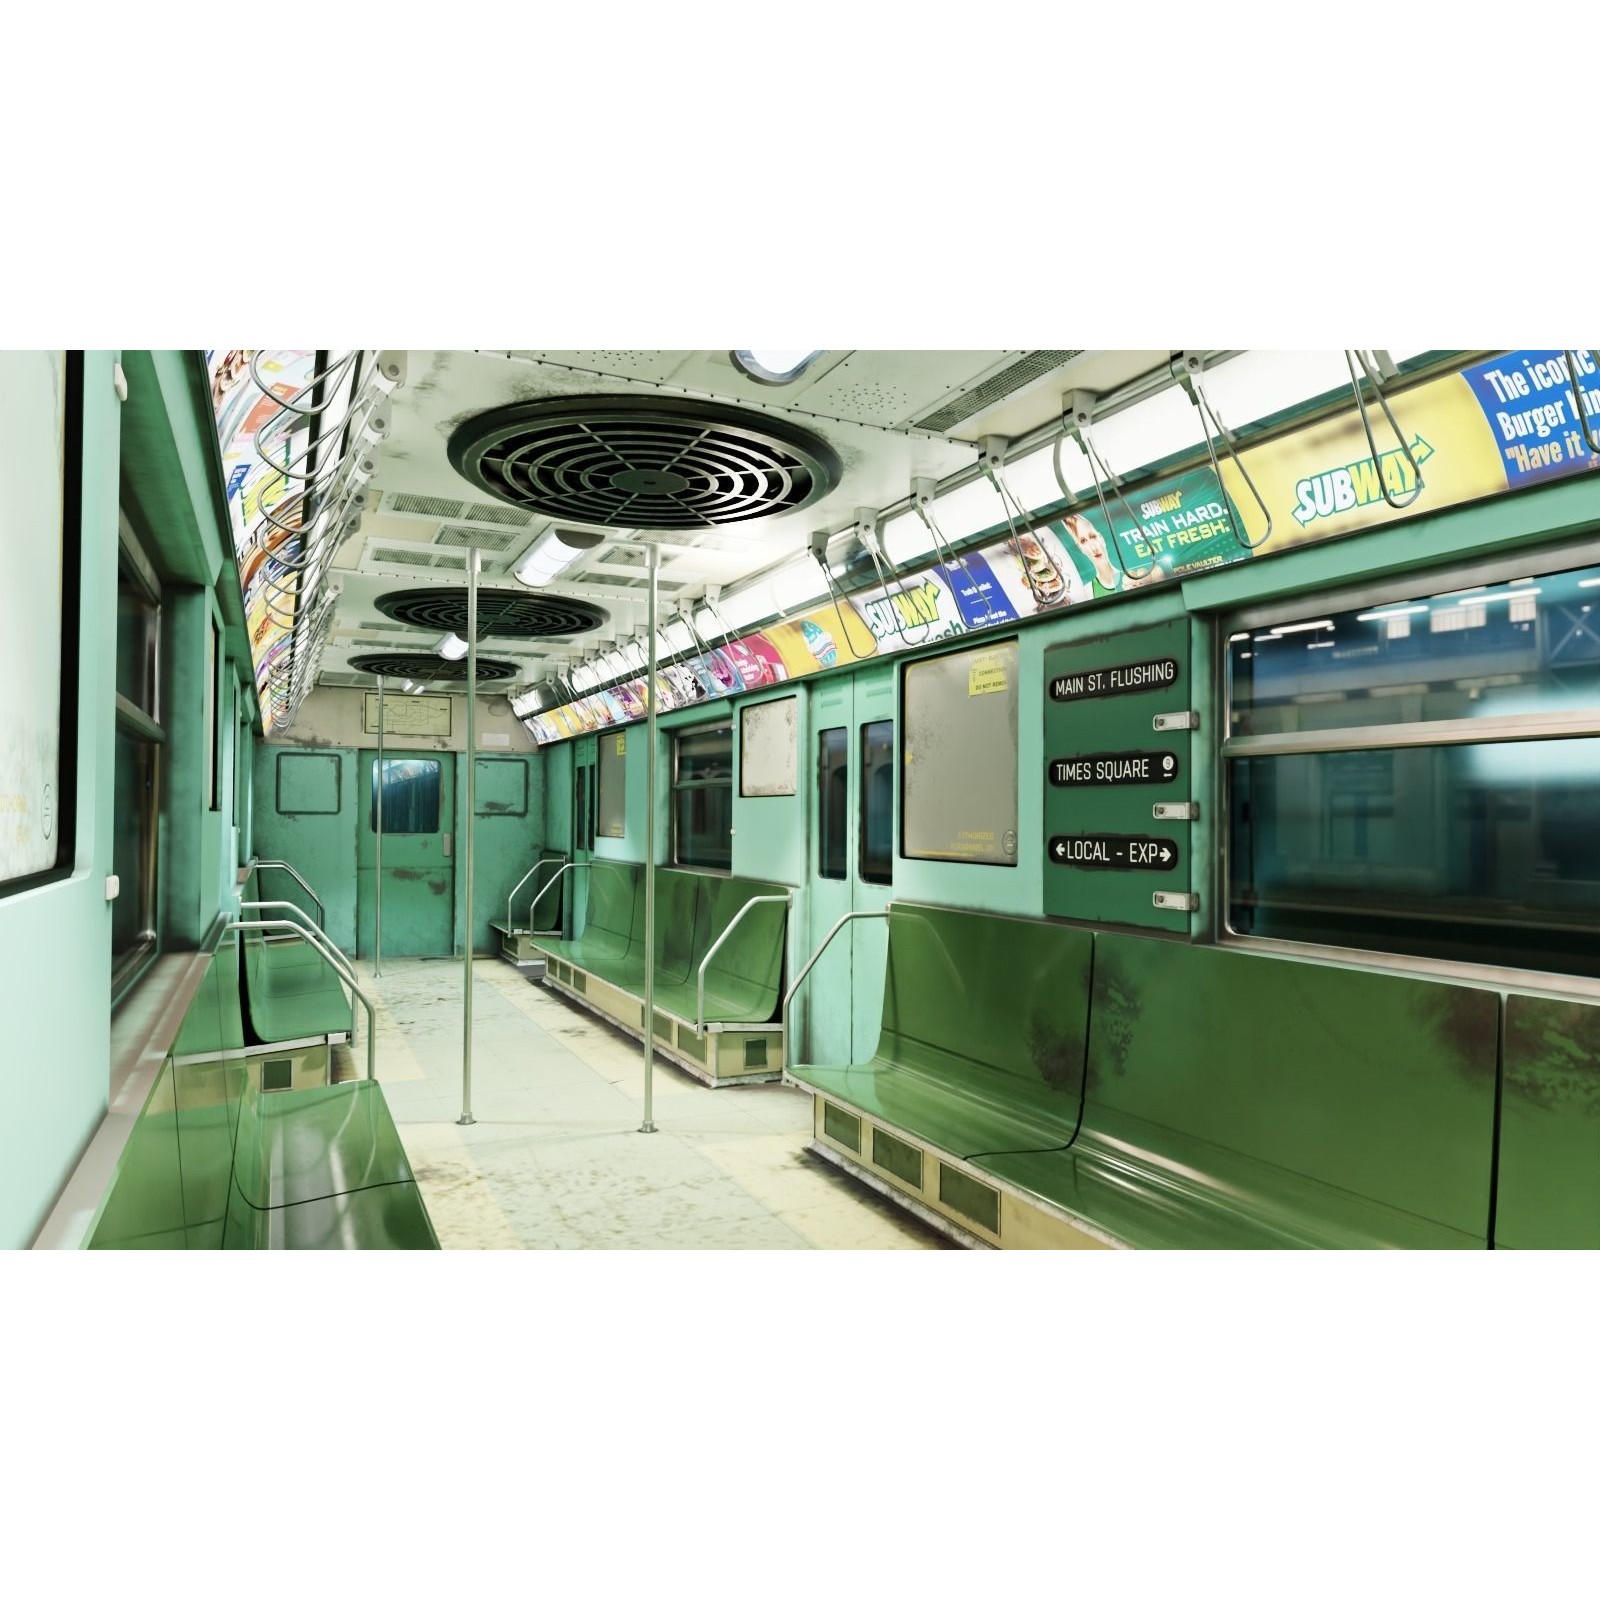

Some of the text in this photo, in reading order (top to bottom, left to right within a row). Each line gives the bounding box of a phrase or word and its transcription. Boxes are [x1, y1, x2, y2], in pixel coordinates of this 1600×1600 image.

[1484, 369, 1530, 403] The
[1496, 399, 1567, 441] Burger
[1505, 440, 1563, 473] "Have
[1563, 430, 1585, 459] it
[1295, 446, 1426, 519] SUBWAY
[1140, 490, 1182, 520] SUBWAY
[1119, 502, 1229, 546] TRAIN HARD.
[1134, 537, 1164, 559] EAT
[1055, 661, 1174, 697] MAIN ST. FLUSHING
[1056, 762, 1091, 781] TIMES
[1096, 758, 1150, 782] SQUARE
[1067, 840, 1110, 862] LOCAL
[1129, 842, 1158, 863] EXP
